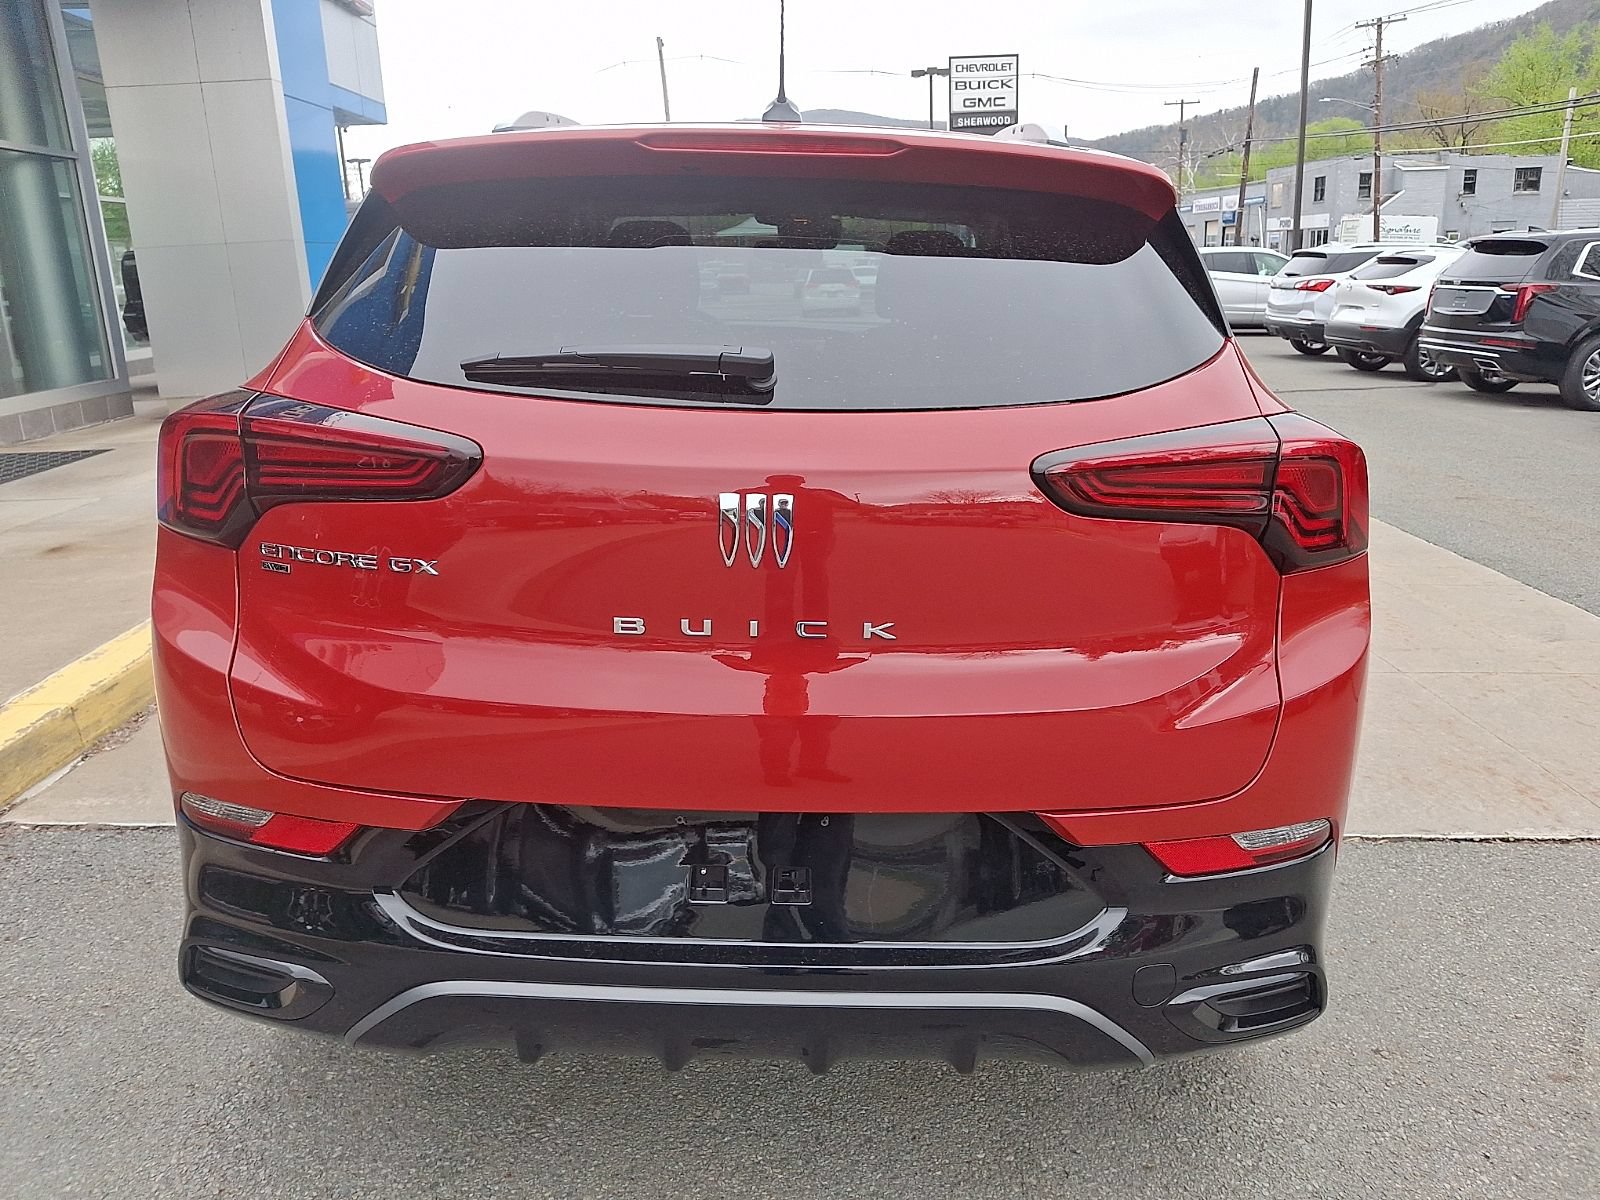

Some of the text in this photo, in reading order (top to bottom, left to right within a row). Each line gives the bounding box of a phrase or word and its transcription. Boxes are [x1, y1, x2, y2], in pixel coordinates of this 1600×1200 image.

[955, 62, 1013, 73] CHEVROLET
[955, 79, 1013, 91] BUICK
[963, 97, 1006, 108] GMC
[957, 116, 1011, 127] SHERWOOD
[259, 542, 440, 576] ENCORE GX
[612, 616, 897, 640] BUICK
